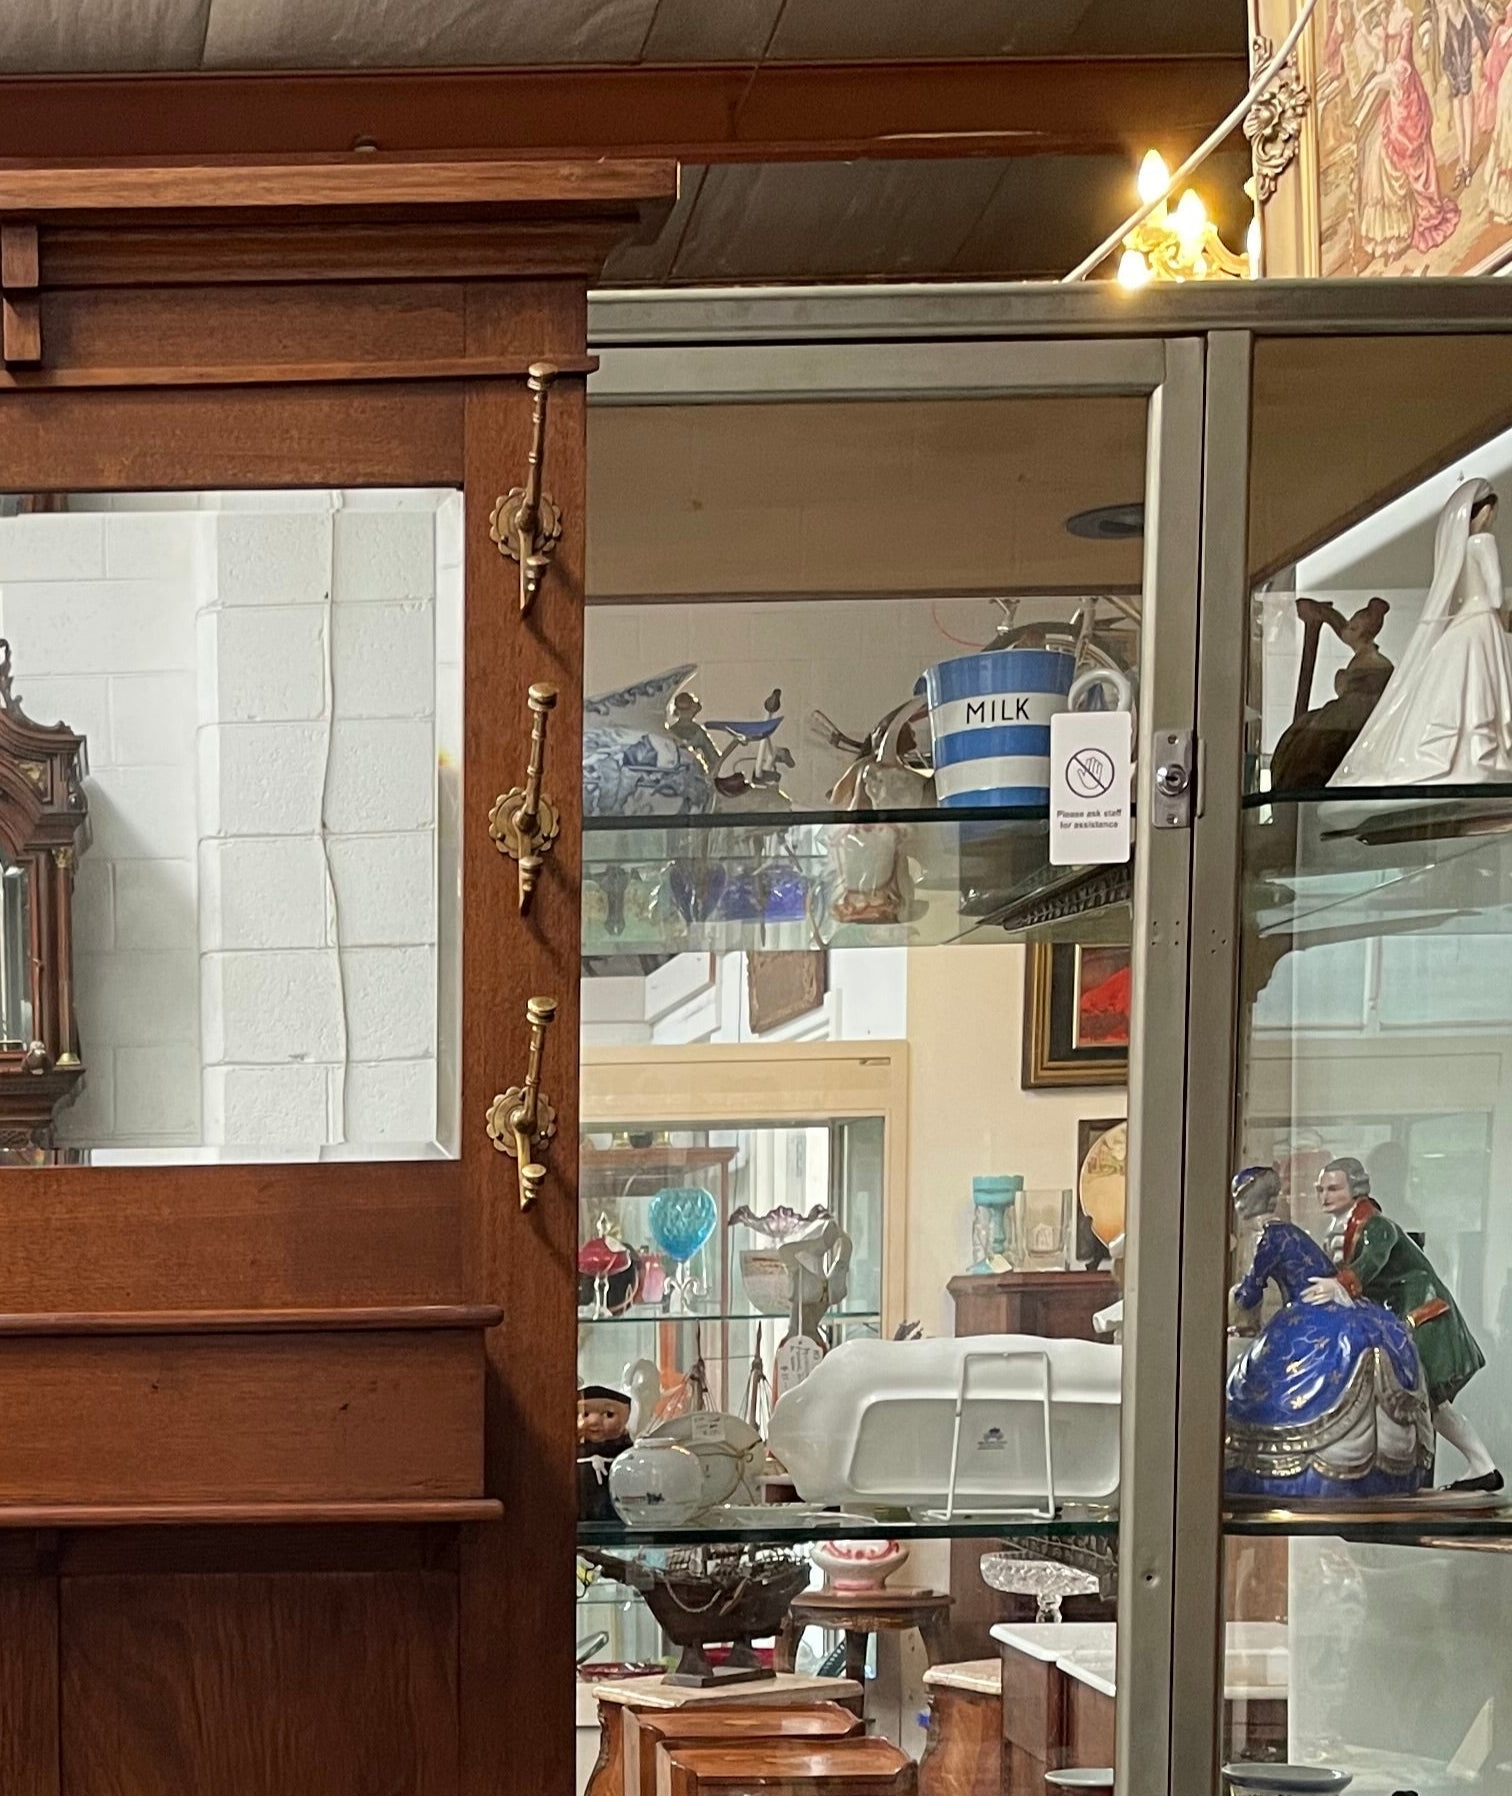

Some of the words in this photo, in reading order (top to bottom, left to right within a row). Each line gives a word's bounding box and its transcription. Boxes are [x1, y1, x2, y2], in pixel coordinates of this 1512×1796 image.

[966, 698, 1030, 724] MILK
[1057, 810, 1084, 818] Please
[1087, 808, 1101, 818] ask
[1103, 808, 1122, 818] staff
[1059, 821, 1072, 829] for
[1074, 821, 1118, 829] assistance
